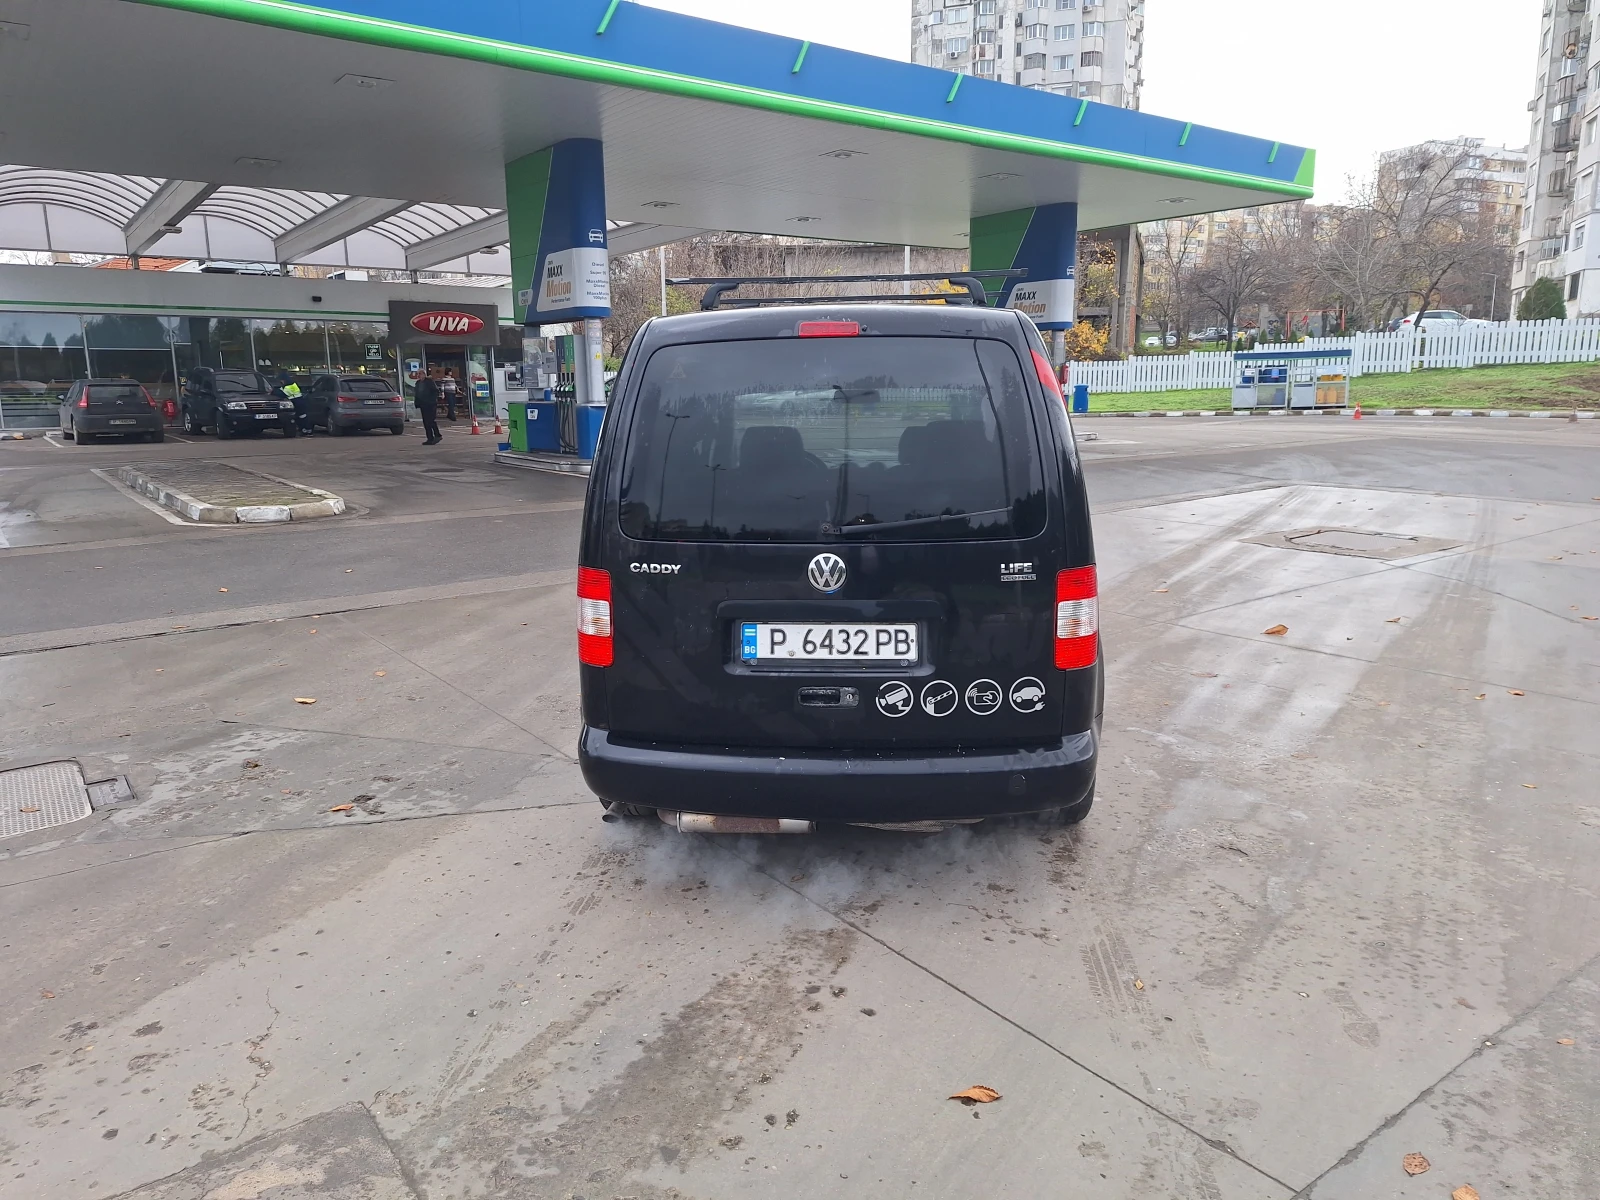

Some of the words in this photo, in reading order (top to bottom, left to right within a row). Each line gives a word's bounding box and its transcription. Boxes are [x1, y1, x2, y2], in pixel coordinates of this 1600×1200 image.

[547, 265, 563, 278] MAXX
[546, 280, 571, 297] Motion
[1014, 291, 1037, 301] MAXX
[429, 315, 469, 332] VIVA
[630, 562, 681, 574] CADDY
[1000, 562, 1032, 573] LIFE
[744, 645, 756, 654] BG
